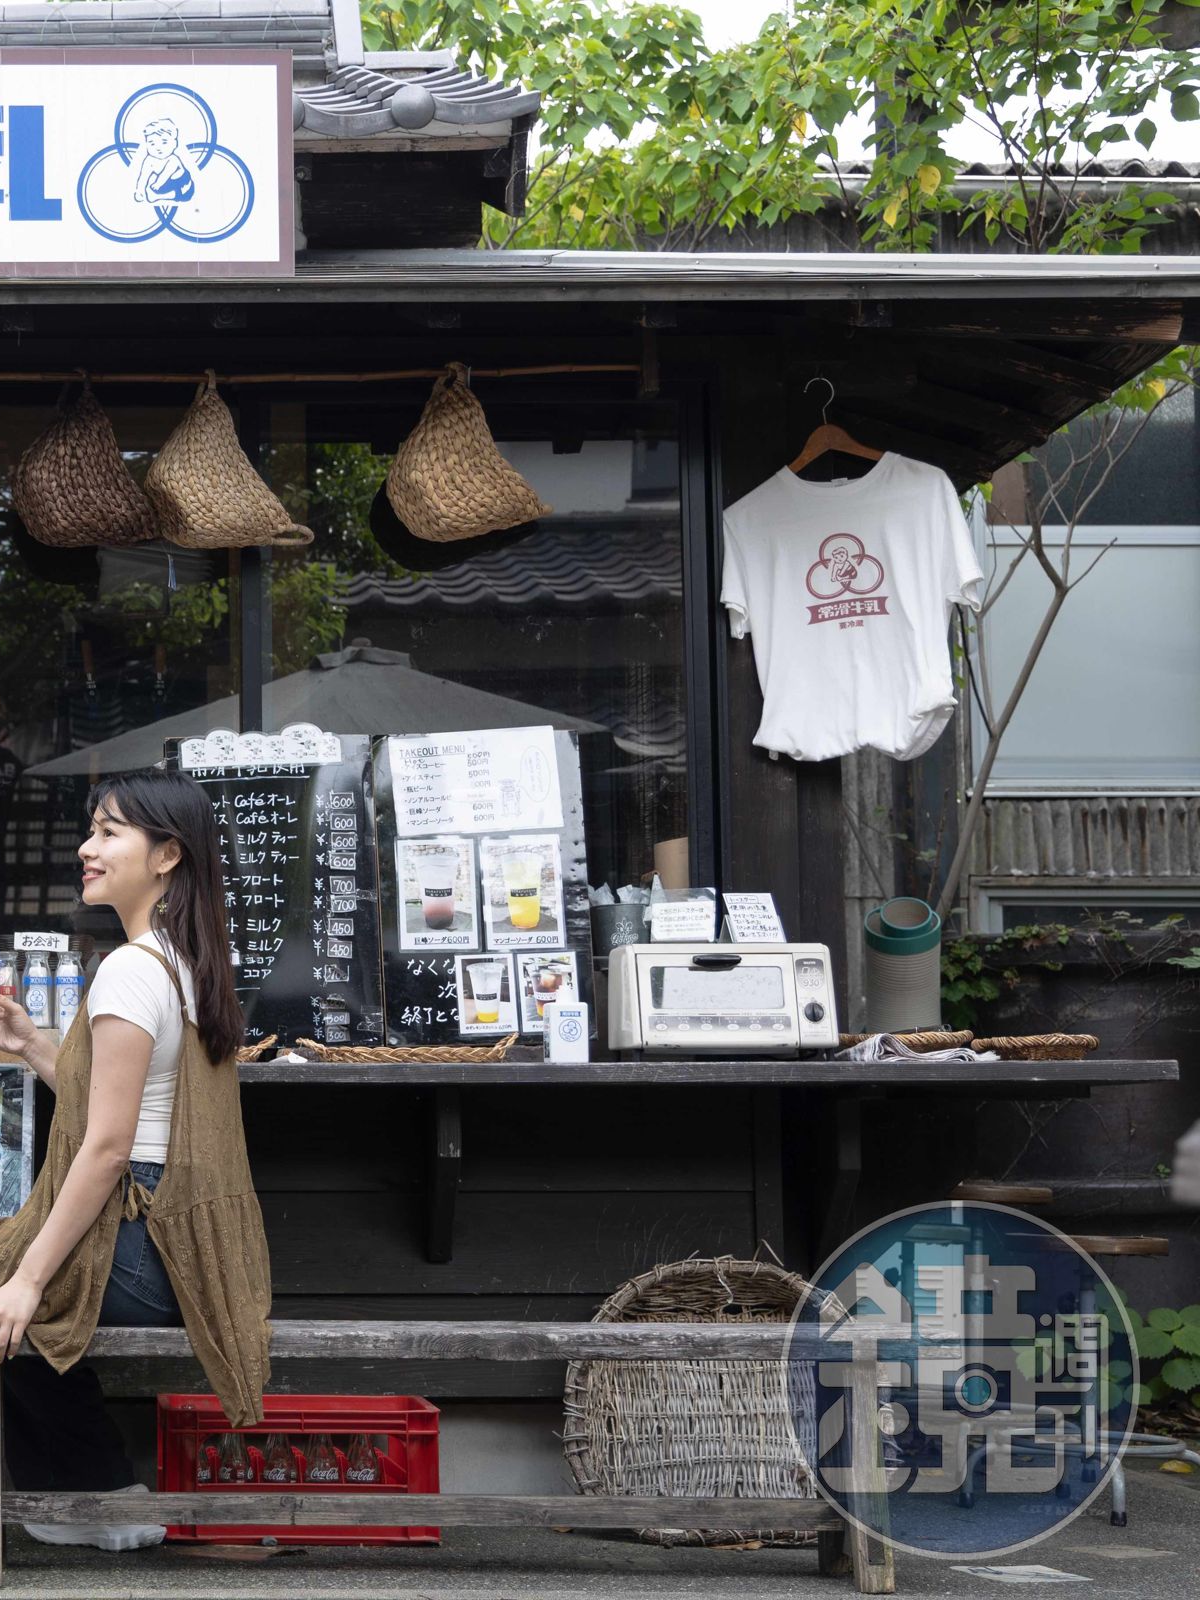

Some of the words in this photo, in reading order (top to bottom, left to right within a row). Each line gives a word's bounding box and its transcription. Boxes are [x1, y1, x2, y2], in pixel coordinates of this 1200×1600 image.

[817, 599, 880, 619] 常滑牛乳
[399, 747, 439, 757] TAKEOUT
[442, 744, 466, 754] MENU
[21, 935, 60, 948] お会計
